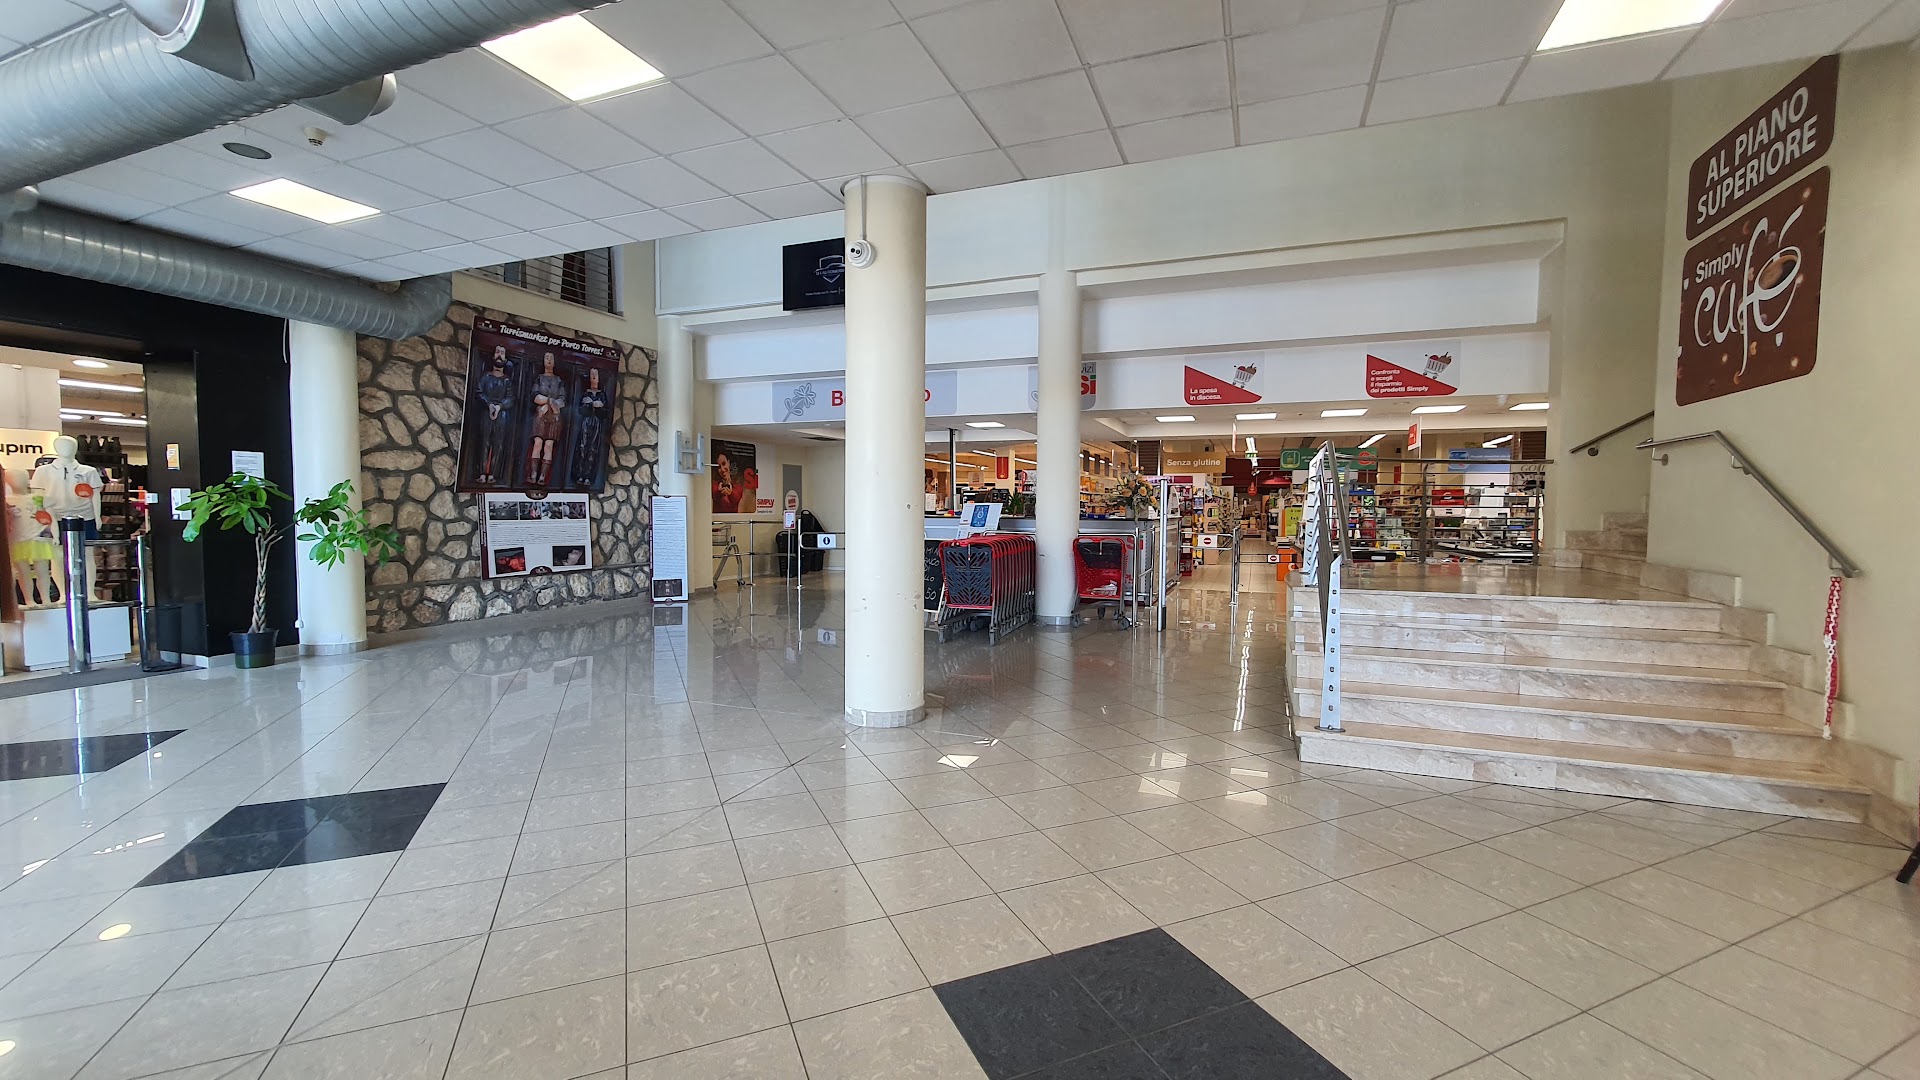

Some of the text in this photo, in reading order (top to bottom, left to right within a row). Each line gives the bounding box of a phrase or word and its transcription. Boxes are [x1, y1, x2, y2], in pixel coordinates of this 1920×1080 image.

[1705, 86, 1809, 188] AL PIANO
[1696, 114, 1818, 225] SUPERIORE
[1694, 242, 1746, 284] Simply
[500, 324, 604, 356] Turrismarket per Porto Torres!
[1375, 374, 1394, 382] scegli
[1375, 380, 1403, 388] risparmio
[1199, 387, 1218, 395] spesa
[1380, 386, 1405, 394] prodotti
[1406, 385, 1429, 393] Simply
[1166, 458, 1221, 468] Senza glutine
